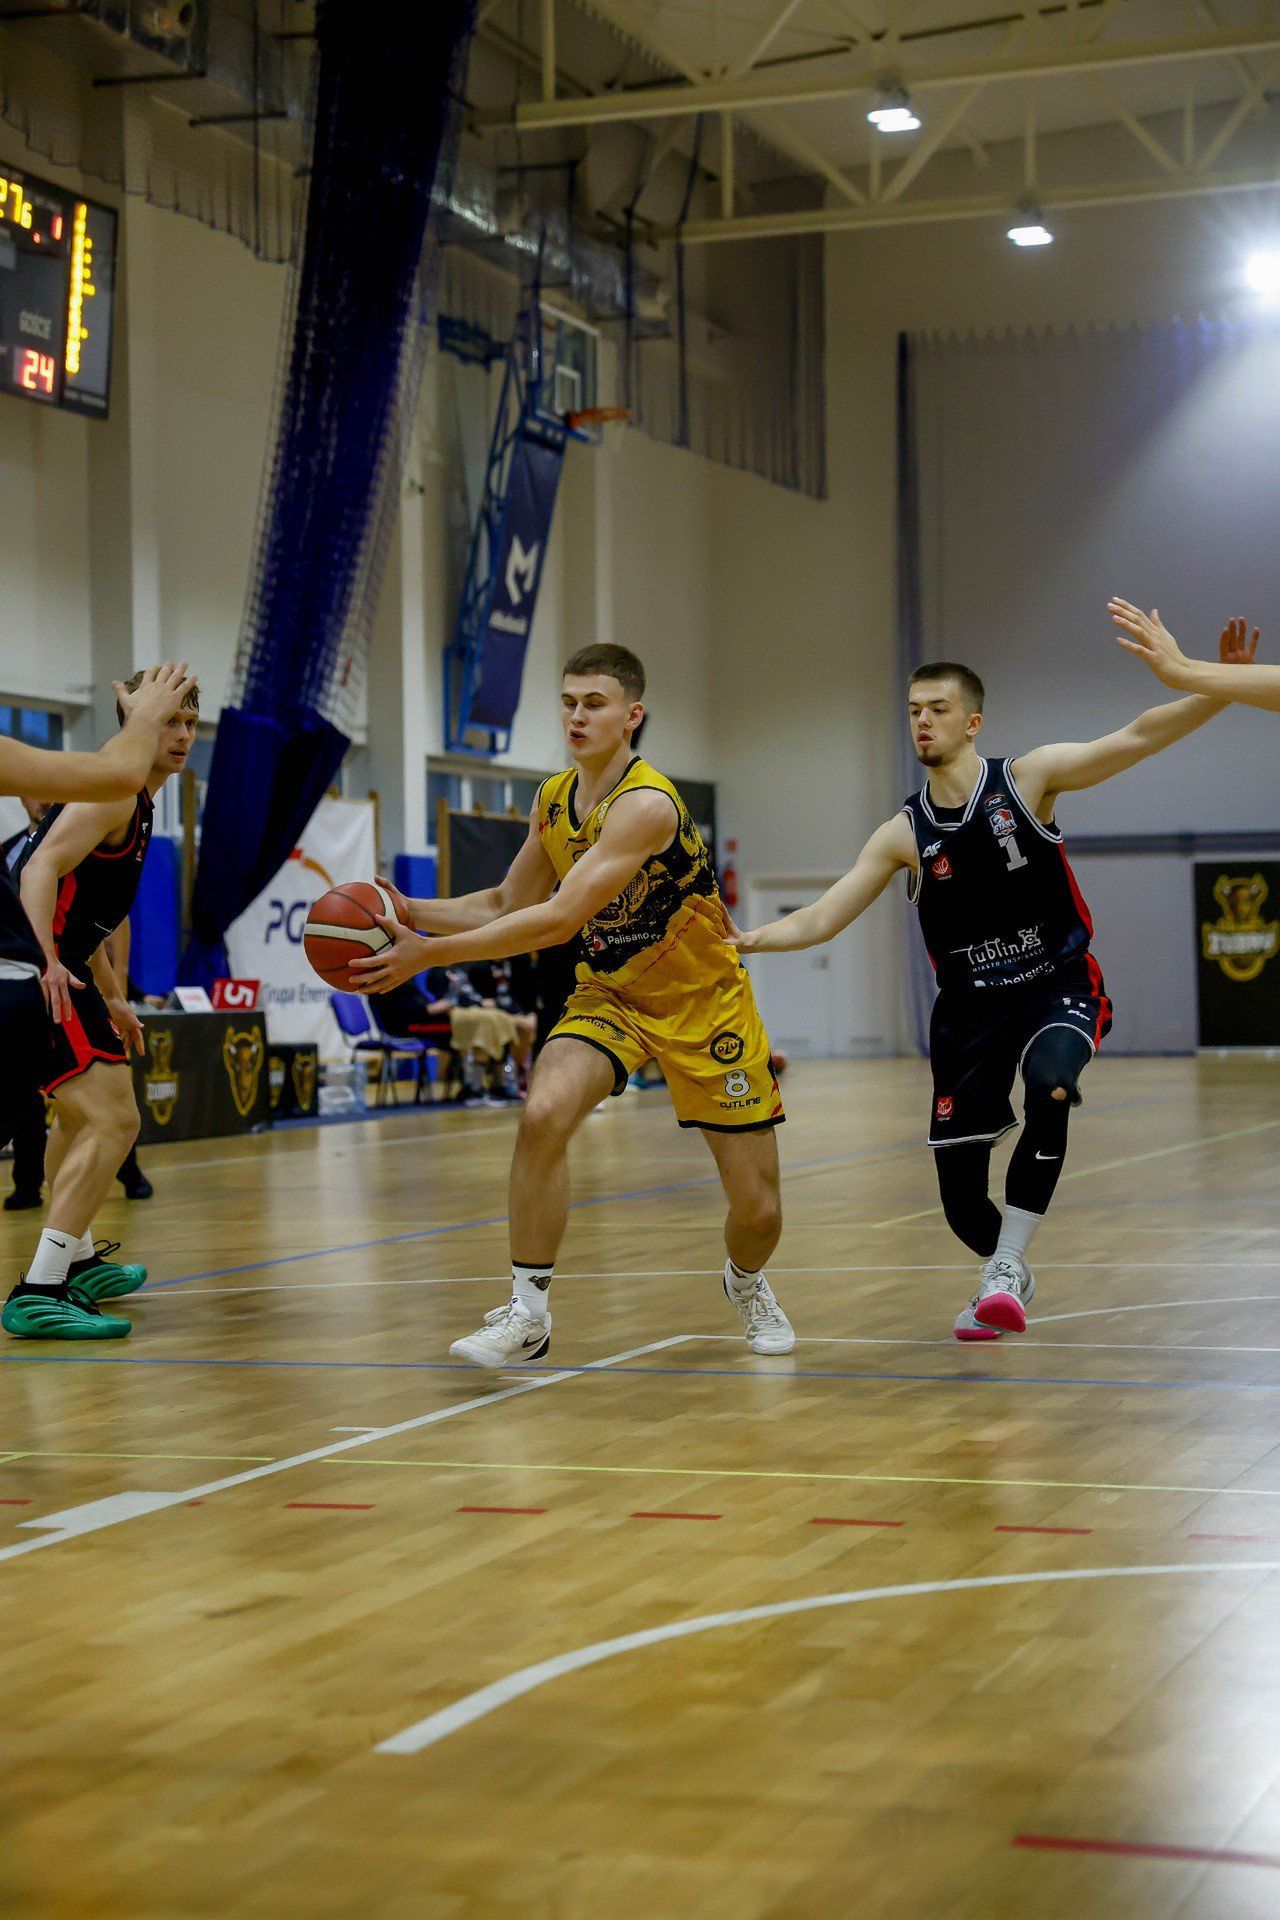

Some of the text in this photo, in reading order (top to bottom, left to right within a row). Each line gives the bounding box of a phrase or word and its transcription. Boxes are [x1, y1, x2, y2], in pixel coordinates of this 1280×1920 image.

[22, 348, 55, 394] 24
[997, 834, 1028, 871] 1
[264, 900, 312, 945] PG
[951, 938, 1020, 965] Lublin
[223, 982, 255, 1008] 5
[717, 1041, 738, 1055] PZU
[725, 1069, 750, 1097] 8
